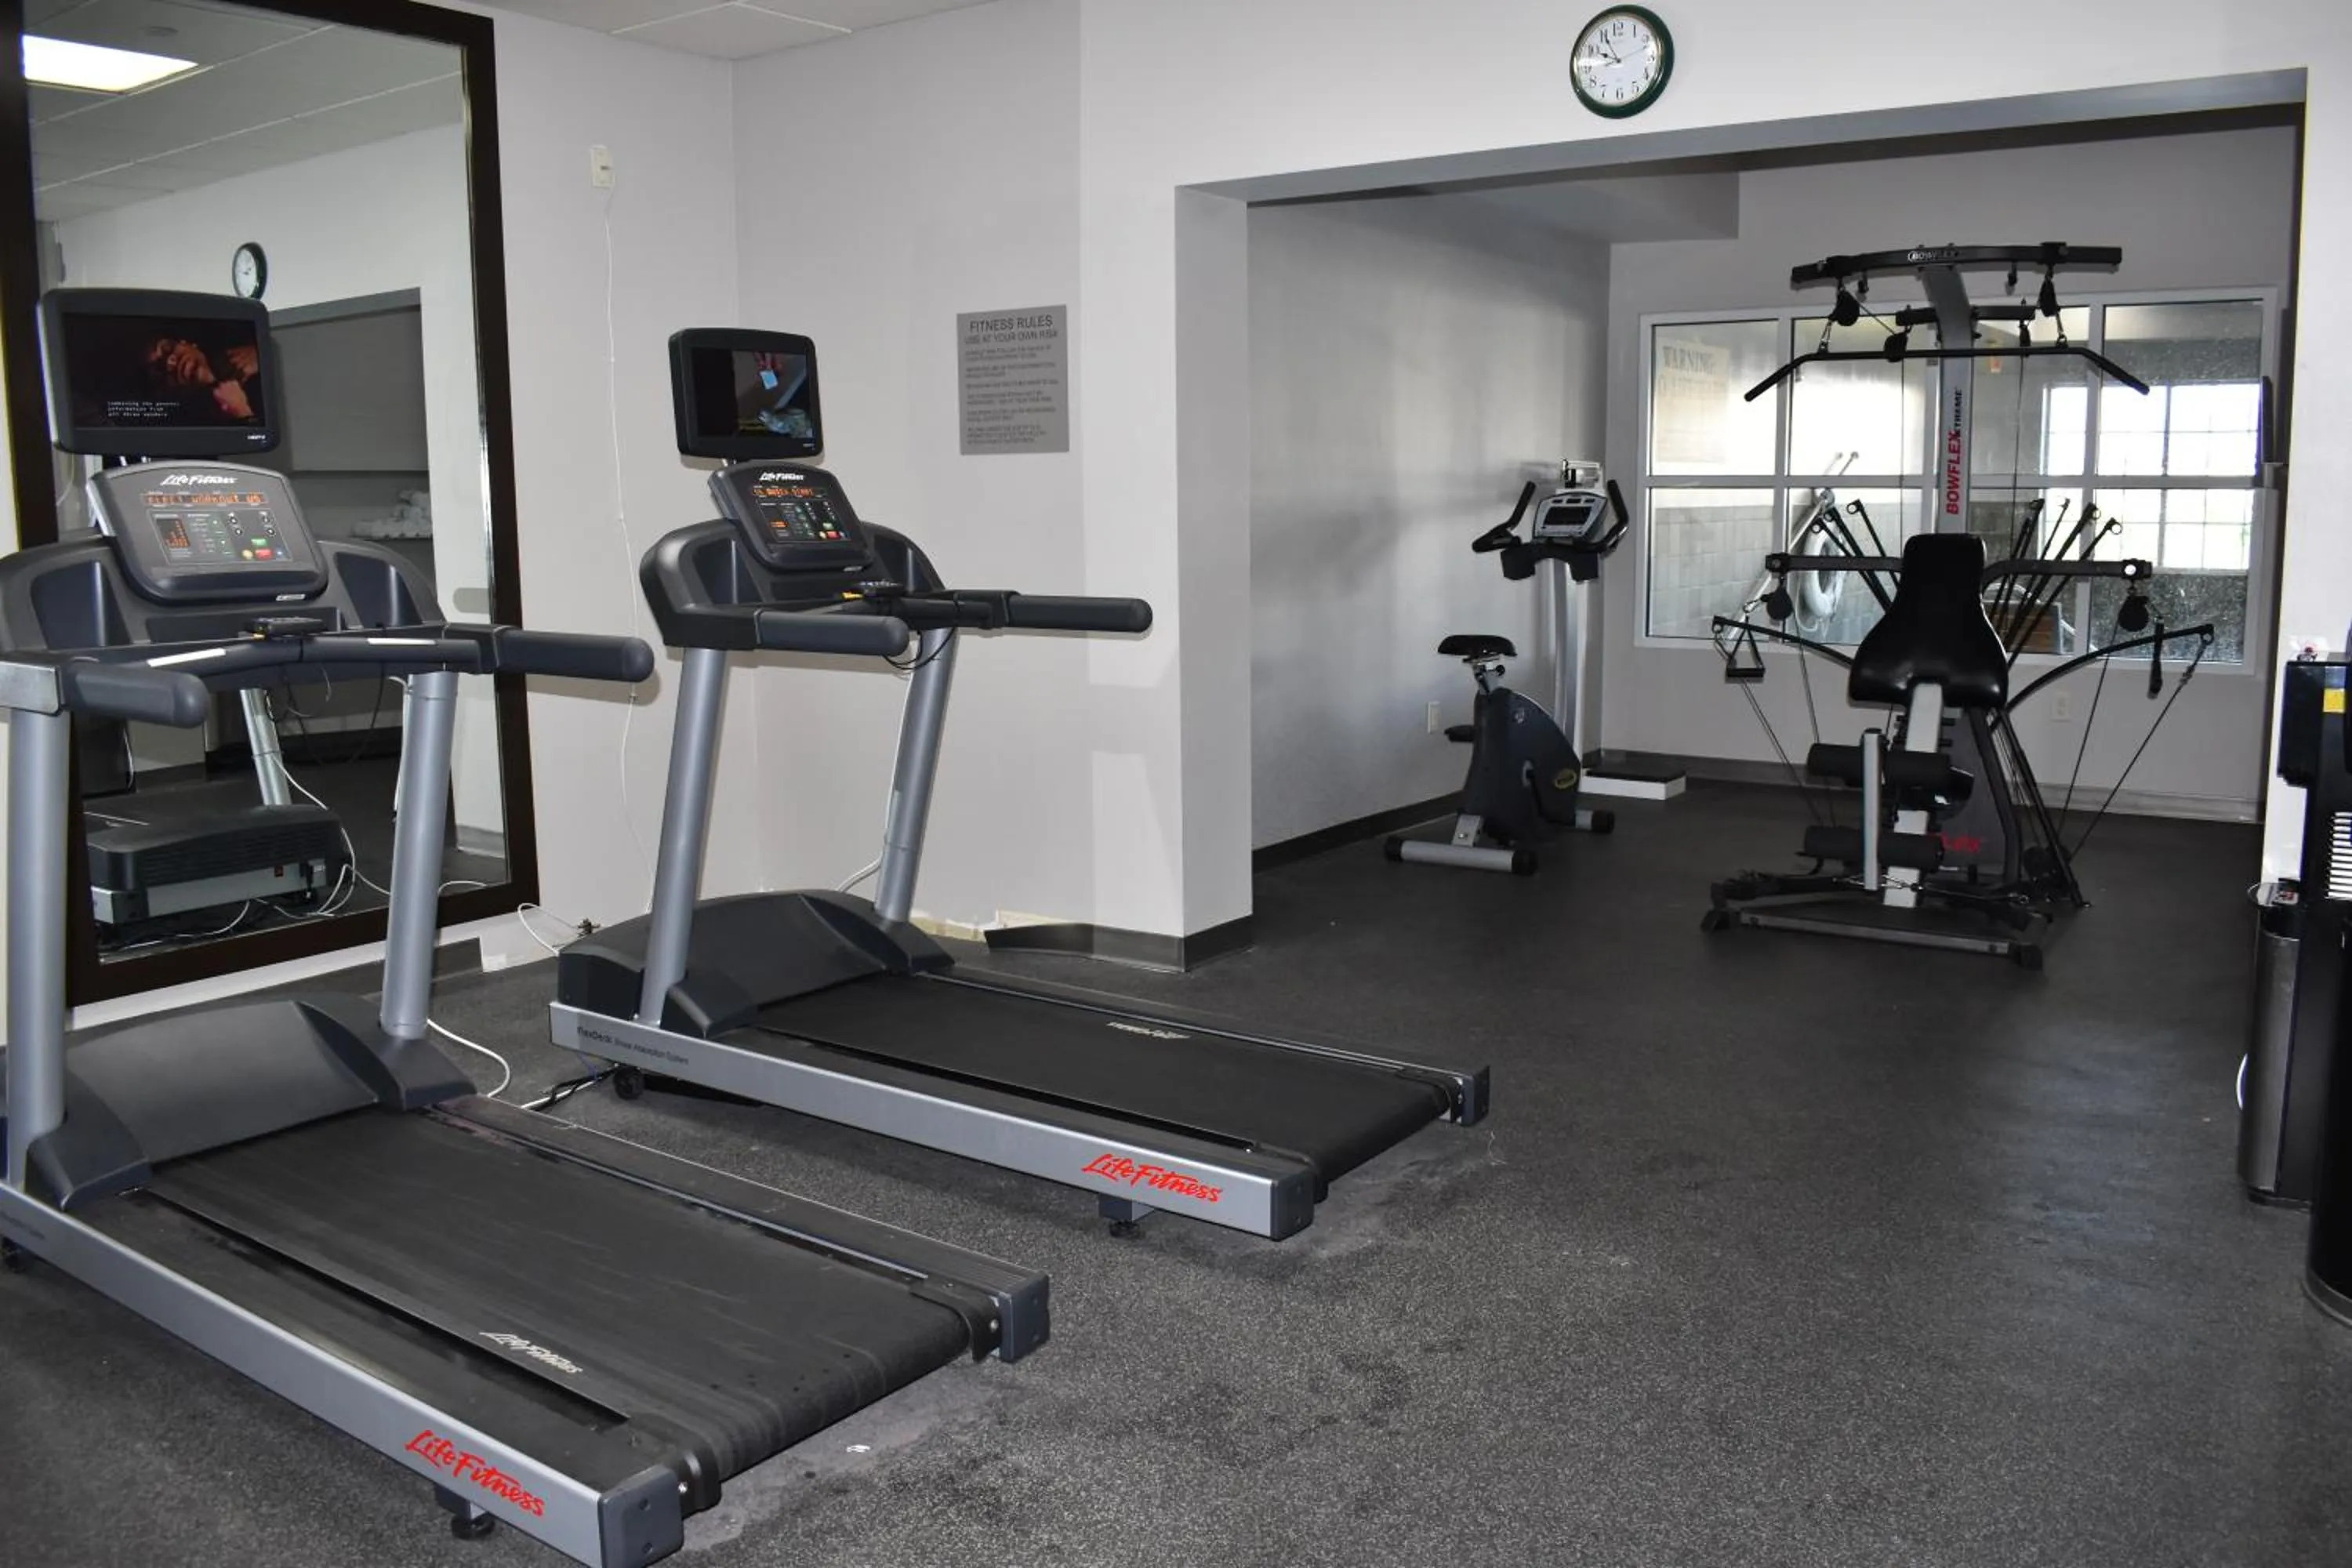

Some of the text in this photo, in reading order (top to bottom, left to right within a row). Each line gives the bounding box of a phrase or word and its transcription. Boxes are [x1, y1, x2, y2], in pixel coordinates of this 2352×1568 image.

[1613, 21, 1624, 36] 12
[1600, 84, 1606, 98] 7
[1616, 87, 1624, 100] 6
[970, 314, 1053, 332] FITNESS RULES
[993, 332, 1016, 343] YOUR
[1018, 330, 1037, 342] OWN
[1945, 430, 1962, 515] BOWFLEX
[1081, 1153, 1223, 1203] Life Fitness
[405, 1429, 546, 1517] Life Fitness
